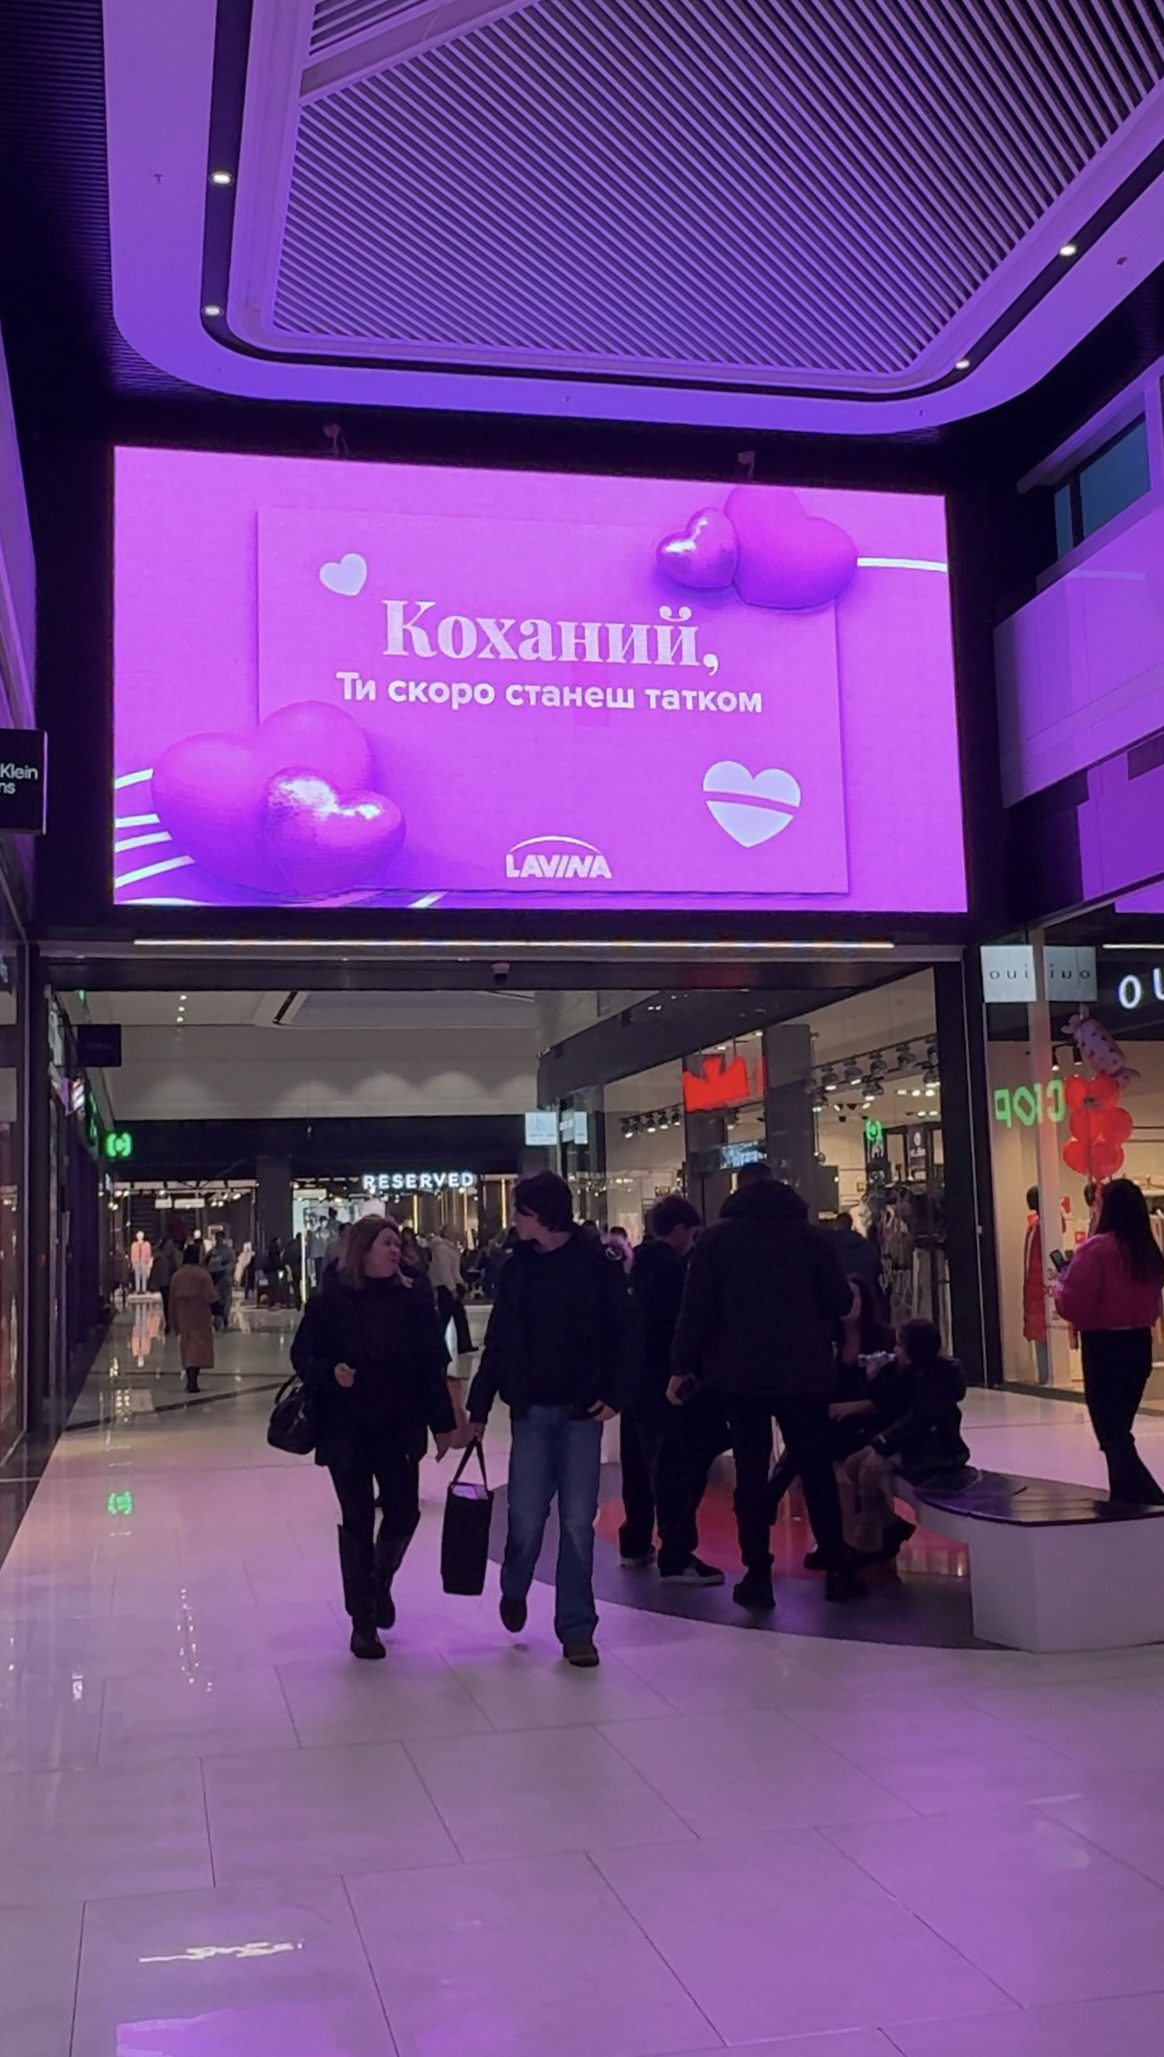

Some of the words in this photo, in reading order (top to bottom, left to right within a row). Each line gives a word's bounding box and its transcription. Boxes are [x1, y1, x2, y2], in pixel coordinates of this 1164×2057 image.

[381, 599, 720, 676] Коханий,
[335, 671, 377, 701] Ти
[387, 679, 496, 710] скоро
[505, 683, 636, 709] станеш
[644, 687, 763, 713] татком
[0, 763, 39, 780] Klein
[505, 853, 613, 879] LAVINA
[362, 1171, 475, 1191] RESERVED
